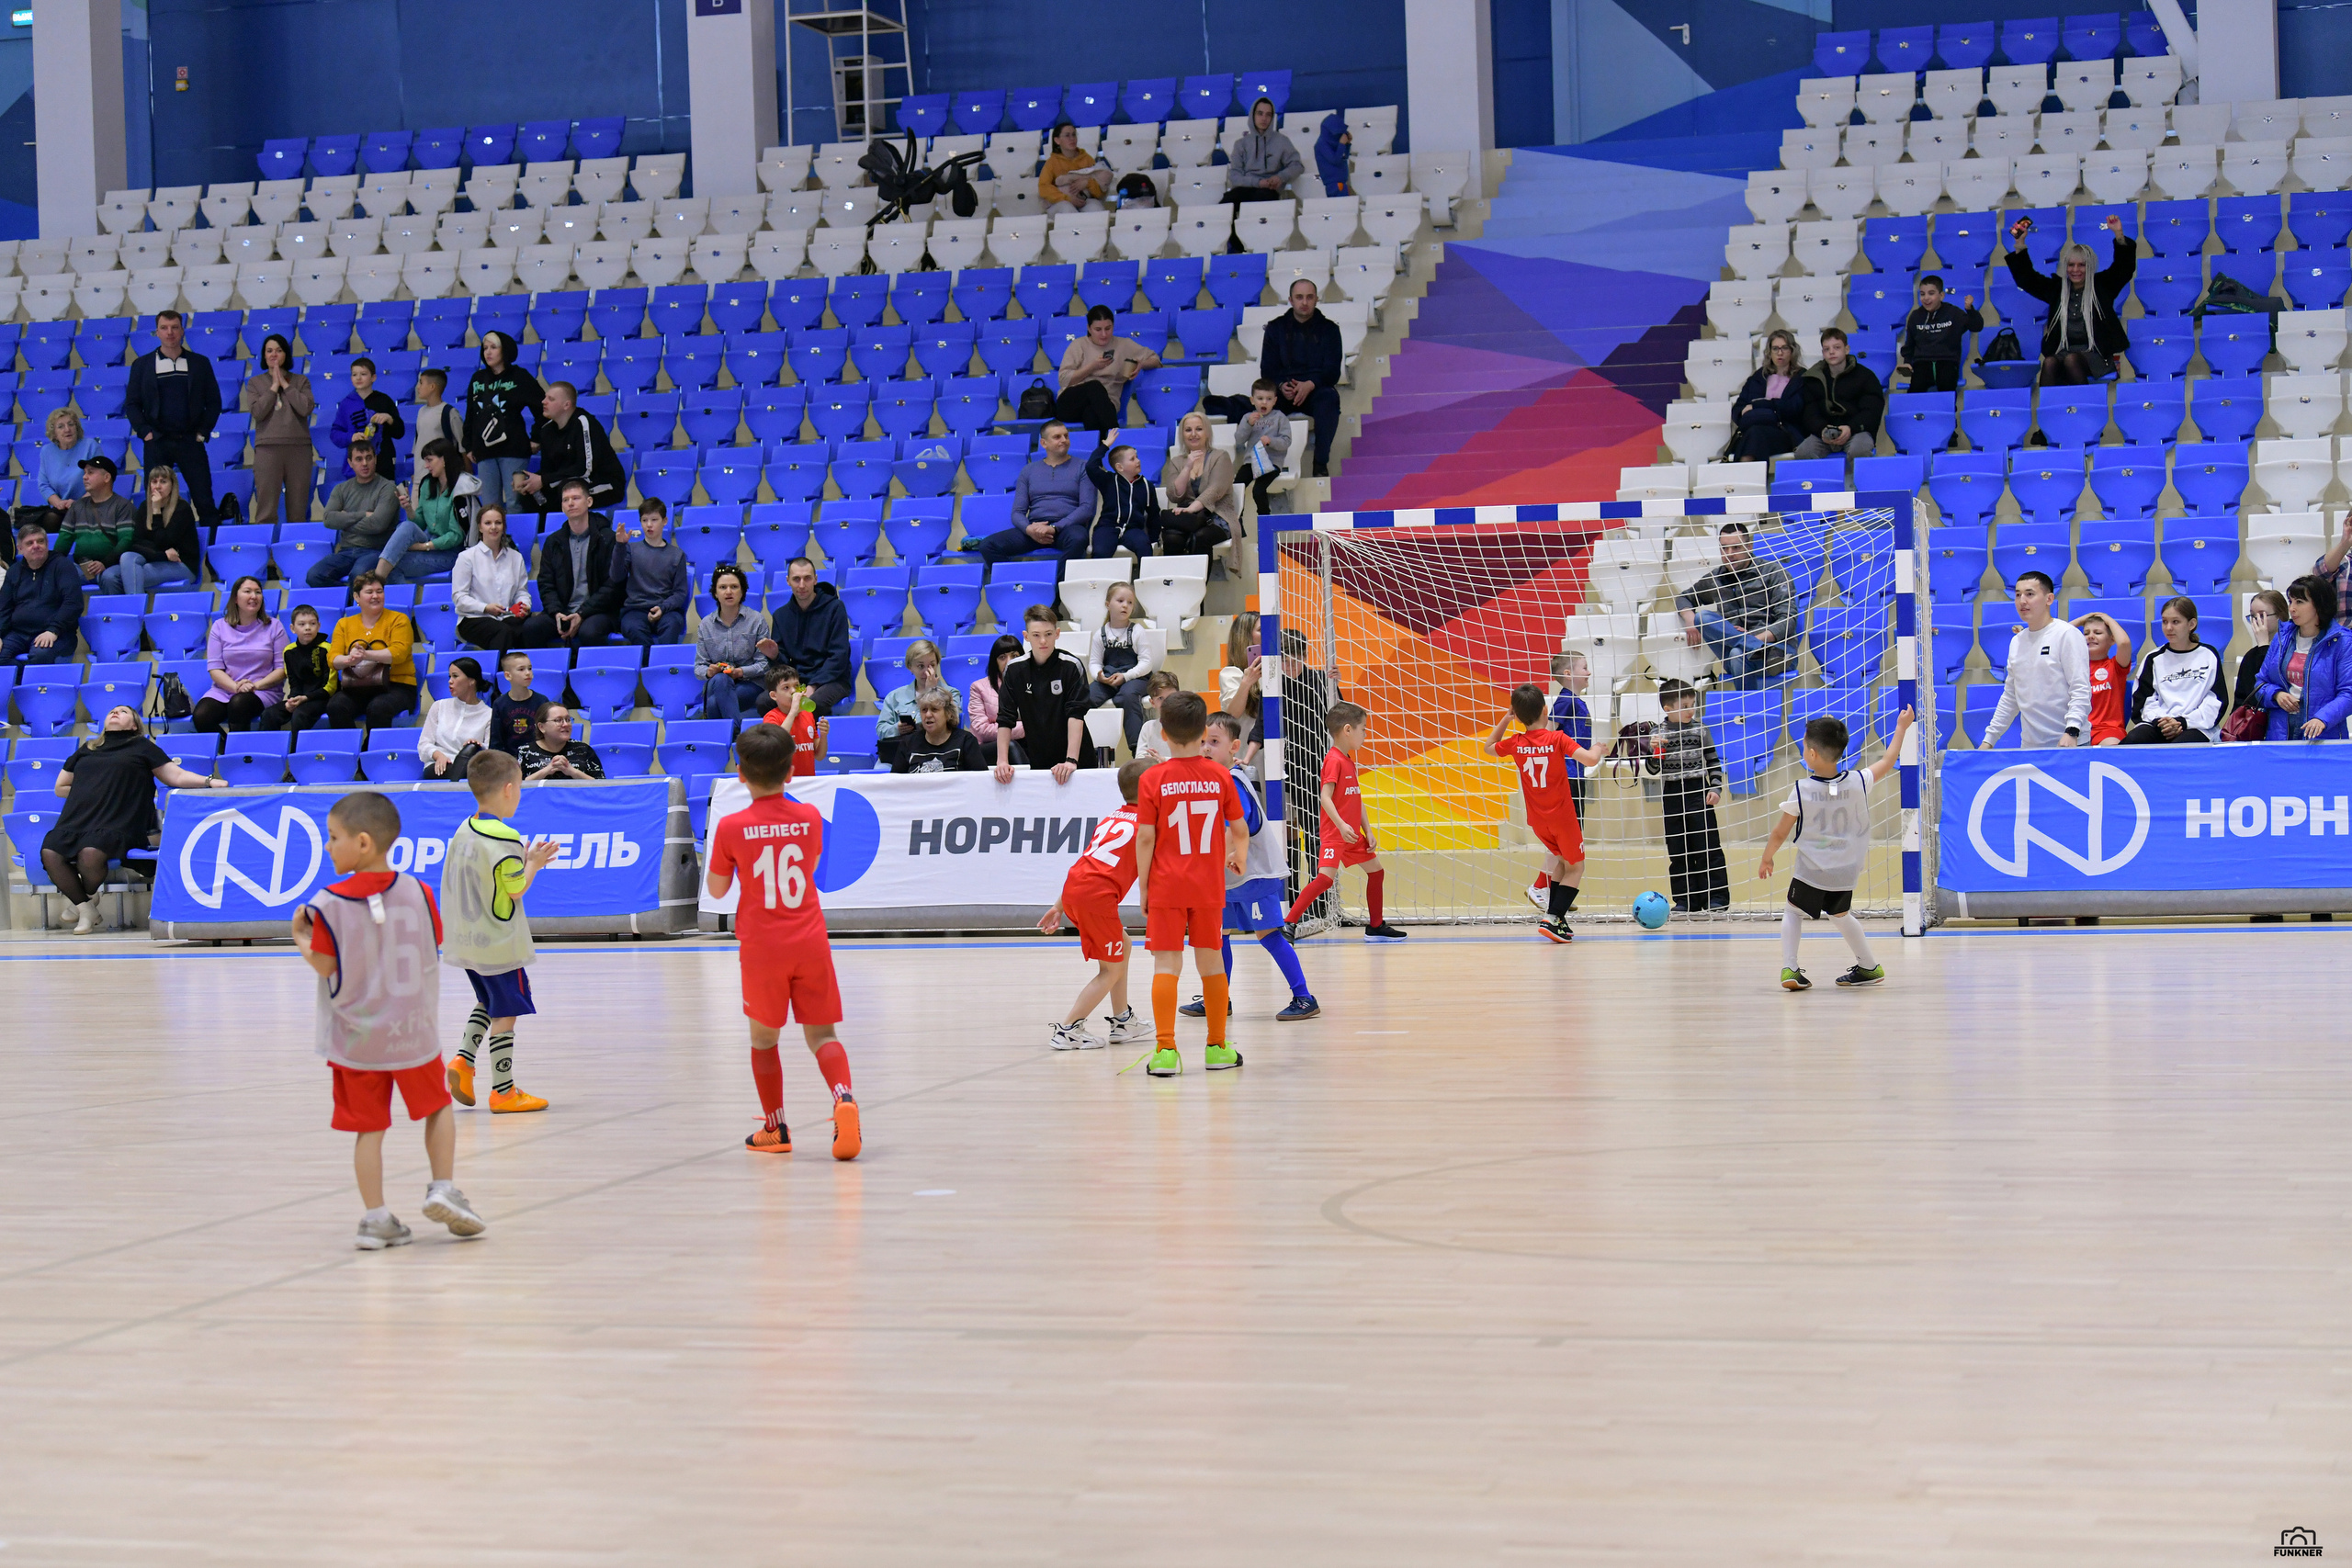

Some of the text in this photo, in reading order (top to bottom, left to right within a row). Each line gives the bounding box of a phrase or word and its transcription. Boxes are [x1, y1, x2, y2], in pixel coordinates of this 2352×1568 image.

[2090, 681, 2112, 693] ИКА
[1516, 744, 1555, 754] ЛЯГИН
[1523, 756, 1549, 788] 17
[1160, 781, 1221, 796] БЕЛОГЛАЗОВ
[1813, 807, 1849, 834] 10
[2185, 795, 2349, 839] НОРН
[742, 822, 811, 840] ШЕЛЕСТ
[1167, 799, 1219, 855] 17
[1082, 819, 1135, 868] 12
[1323, 848, 1335, 860] 23
[753, 843, 807, 909] 16
[1251, 902, 1263, 920] 4
[1104, 941, 1124, 956] 12
